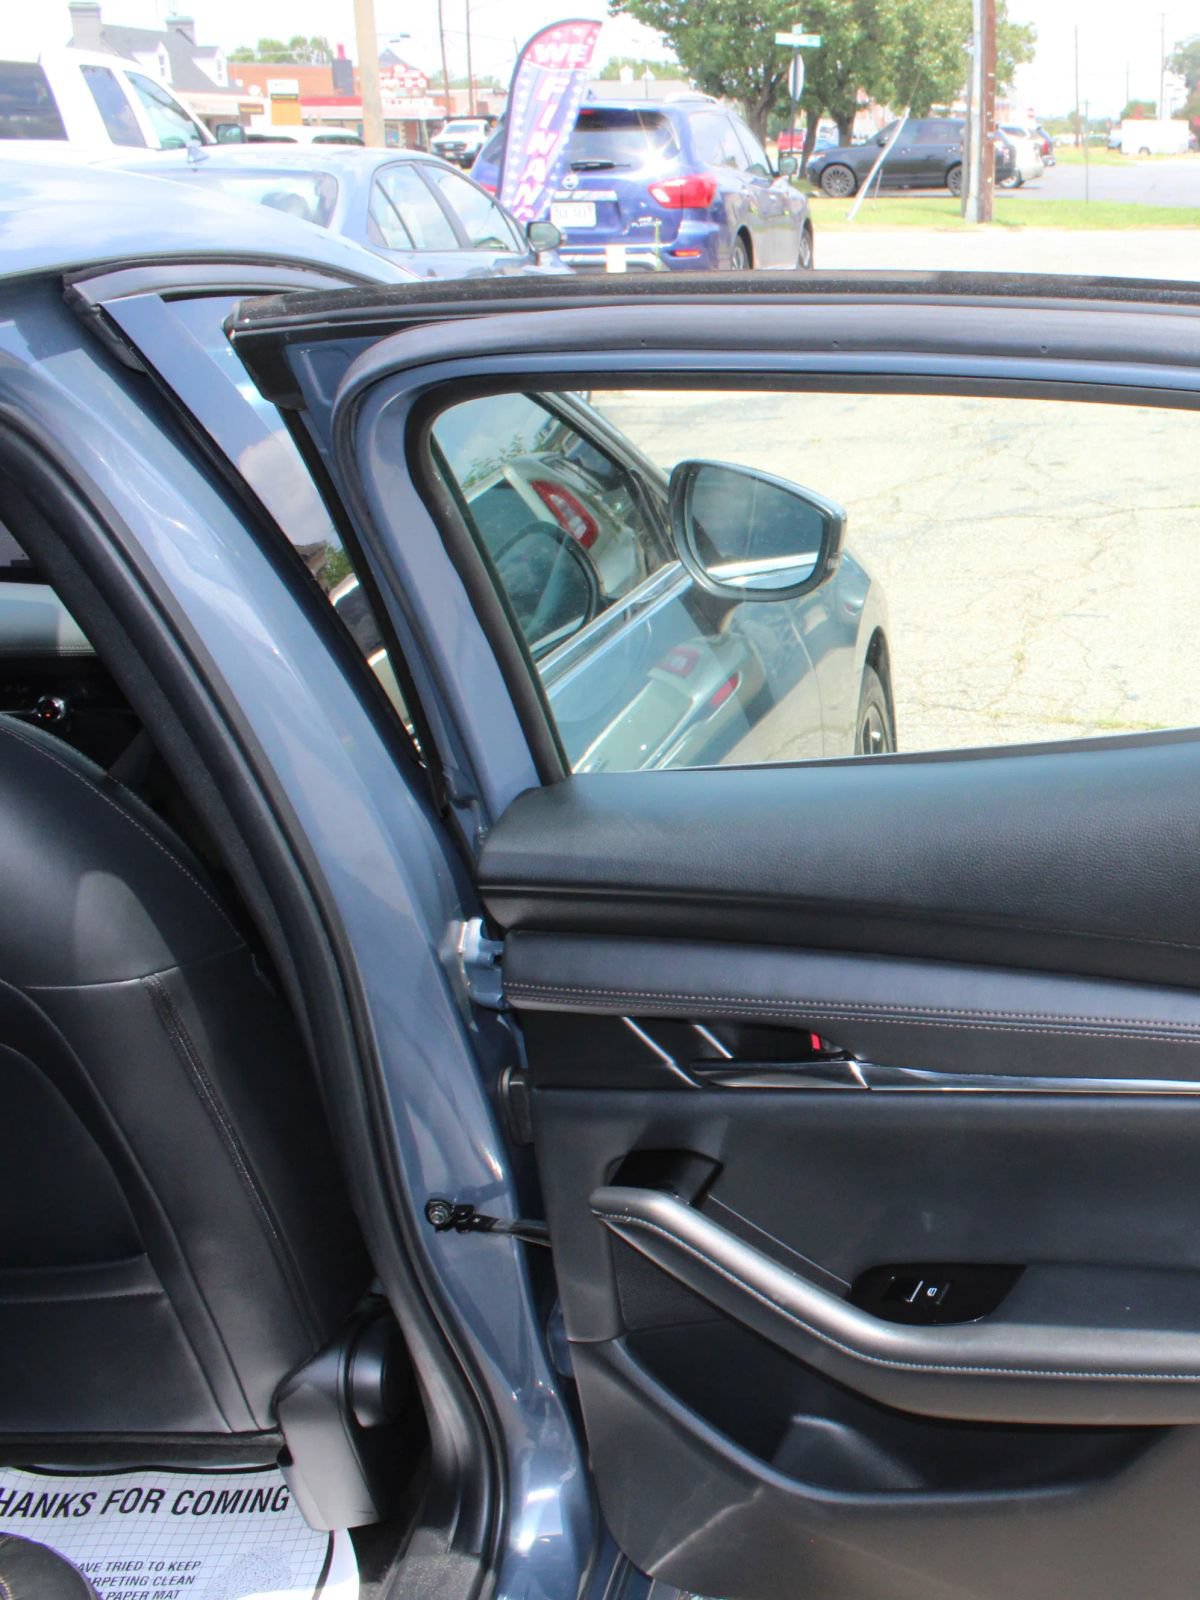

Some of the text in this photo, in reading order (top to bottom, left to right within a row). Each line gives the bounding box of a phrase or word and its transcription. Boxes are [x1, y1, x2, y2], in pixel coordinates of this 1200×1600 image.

[533, 44, 590, 64] WE
[100, 1487, 167, 1515] FOR
[171, 1484, 291, 1516] COMING
[77, 1560, 202, 1573] AVE TRIED TO KEEP
[88, 1575, 196, 1588] RPETING CLEAN
[105, 1589, 182, 1600] PAPER MAT
